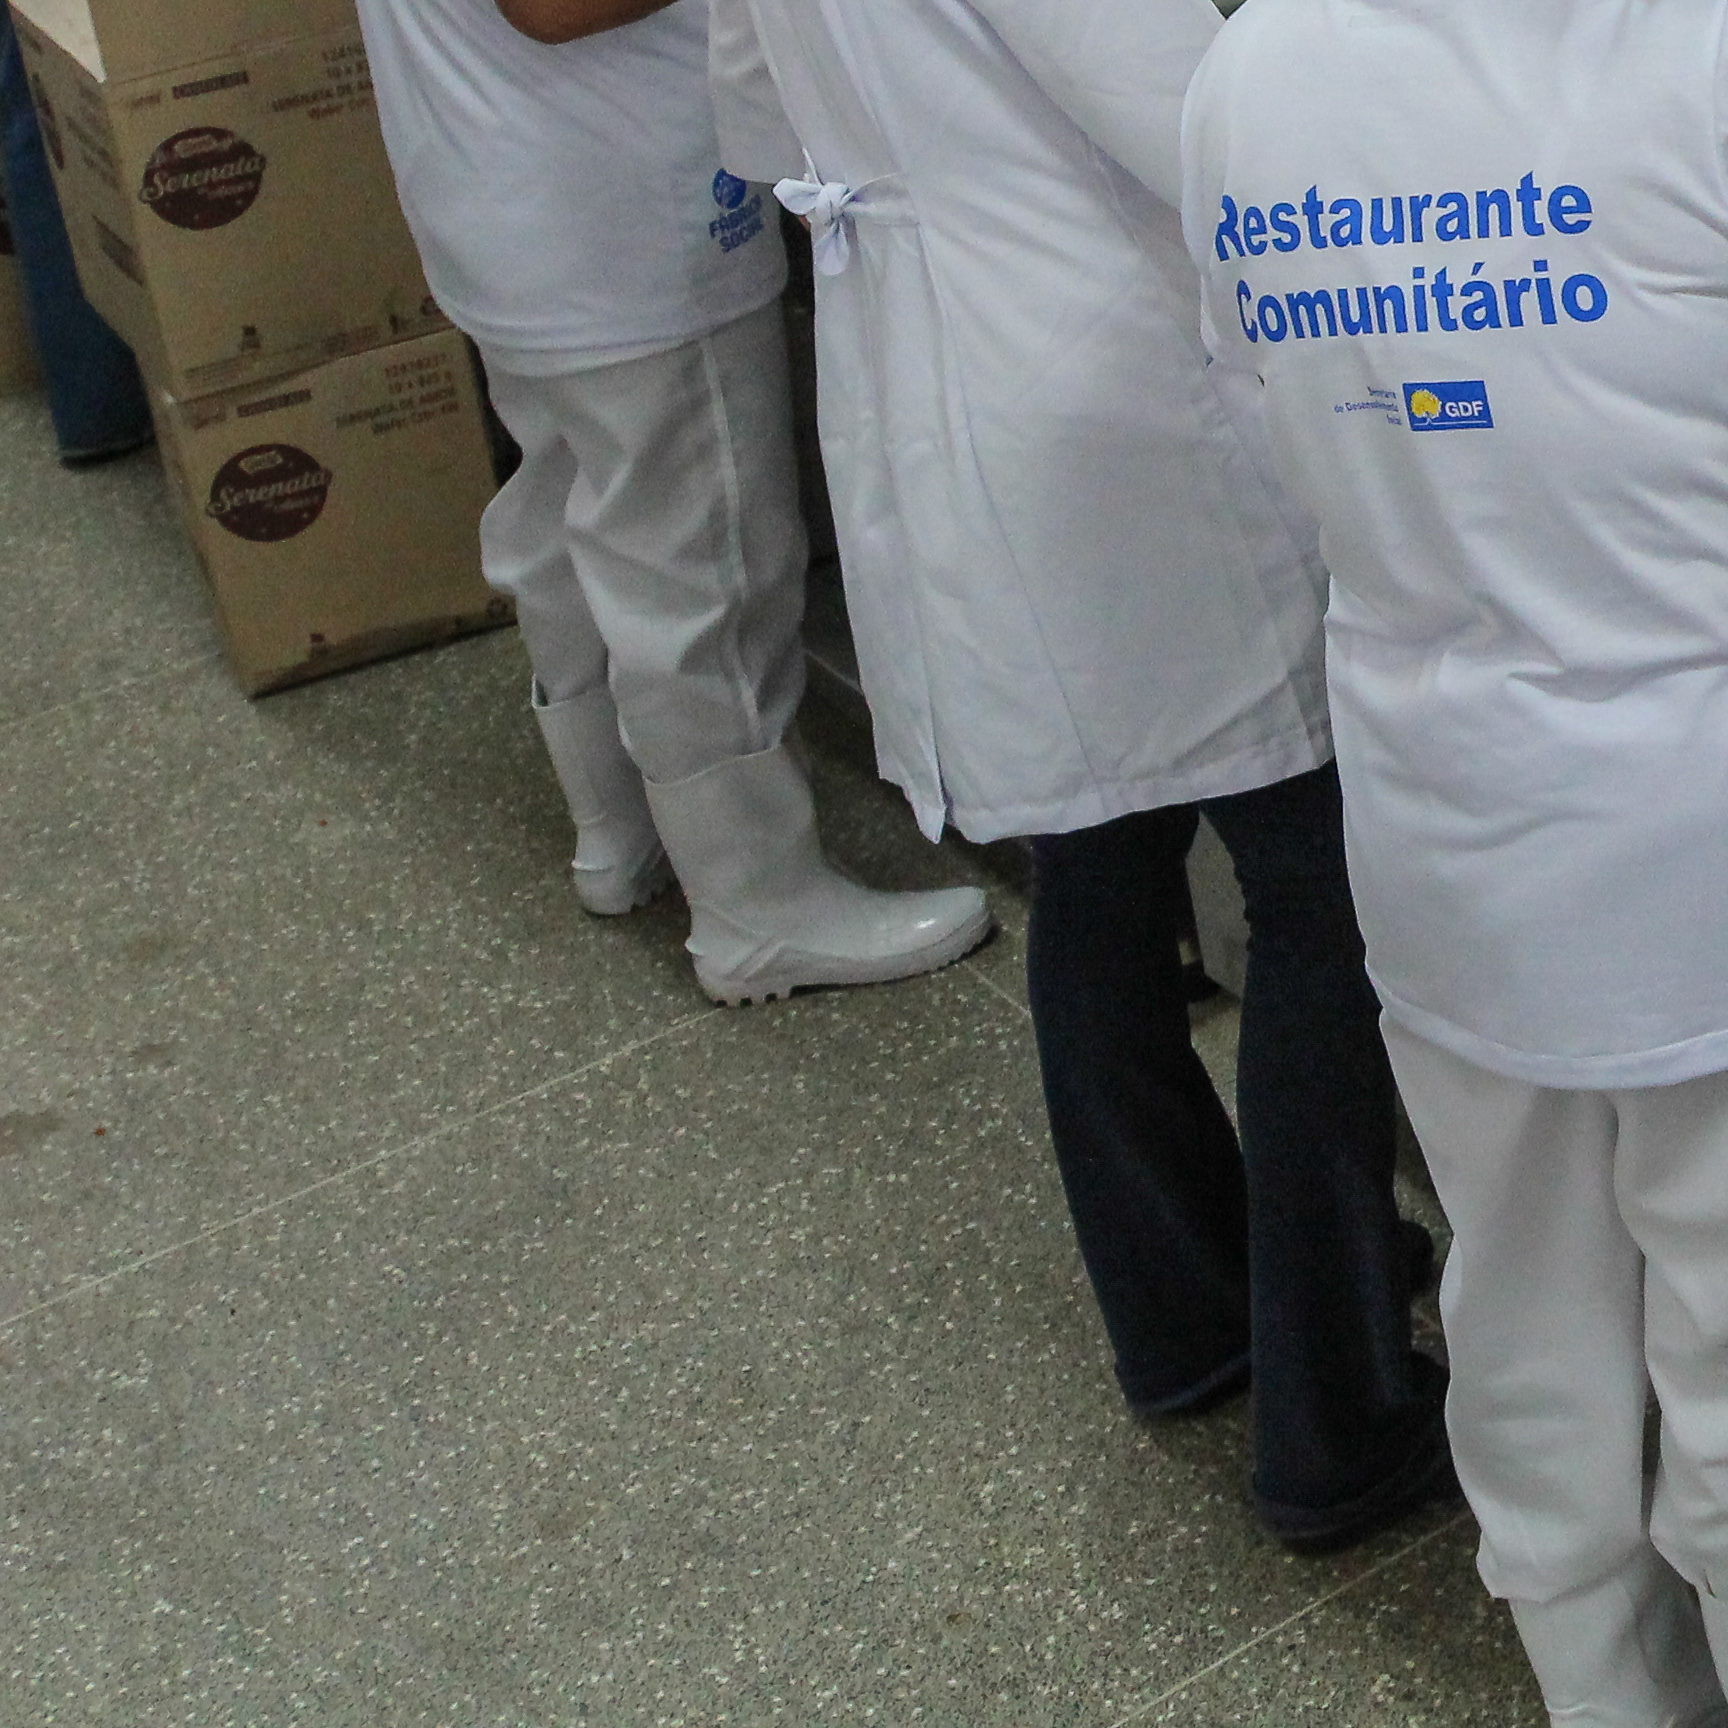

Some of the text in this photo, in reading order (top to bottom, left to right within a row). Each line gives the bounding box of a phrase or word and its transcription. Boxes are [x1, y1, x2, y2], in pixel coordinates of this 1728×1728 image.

[140, 154, 266, 203] Serenata
[1214, 170, 1594, 263] Restaurante
[1236, 259, 1609, 344] Comunitário
[1445, 401, 1484, 417] GDF
[205, 469, 333, 518] Serenata
